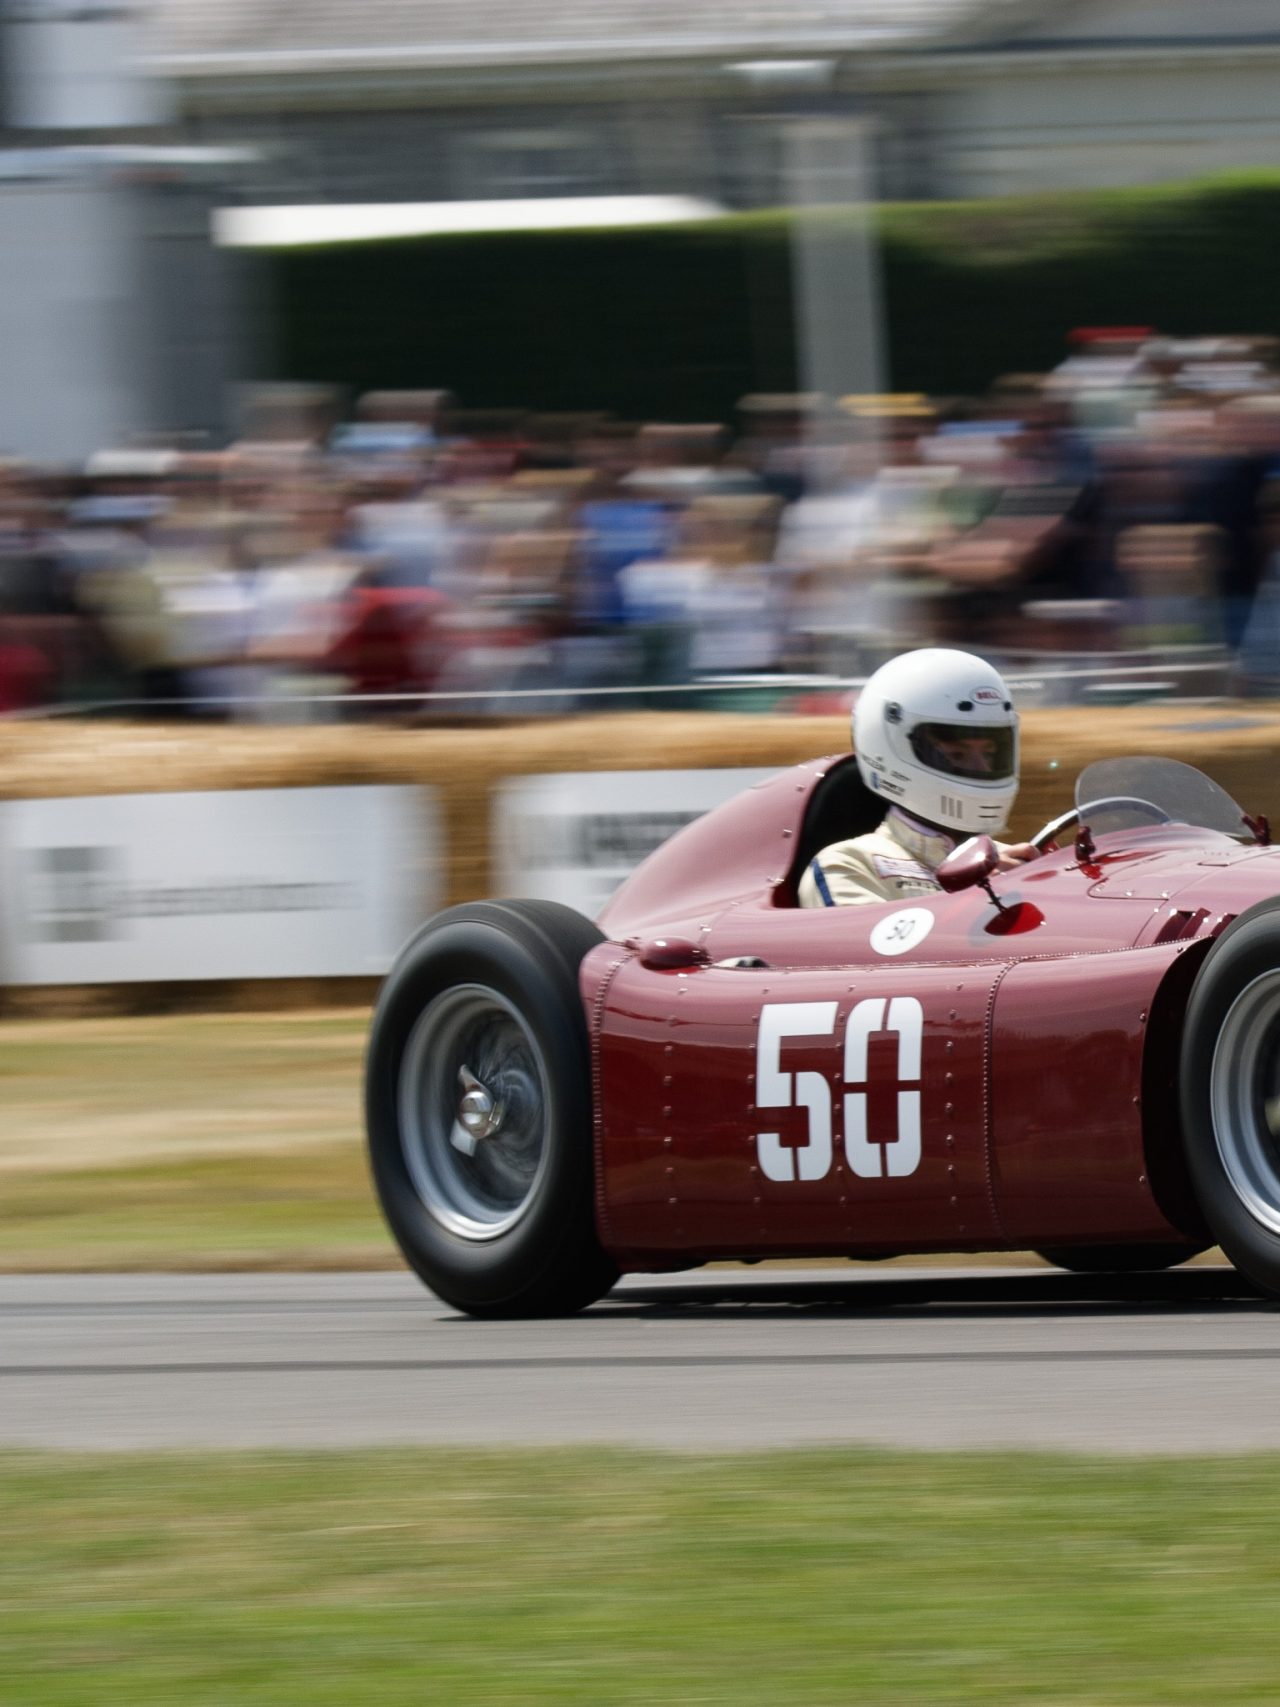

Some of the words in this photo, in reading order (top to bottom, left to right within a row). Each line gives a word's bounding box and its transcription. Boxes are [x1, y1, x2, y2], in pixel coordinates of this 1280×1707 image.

[976, 691, 1001, 700] BELL
[886, 919, 916, 941] 50
[756, 997, 923, 1181] 50
